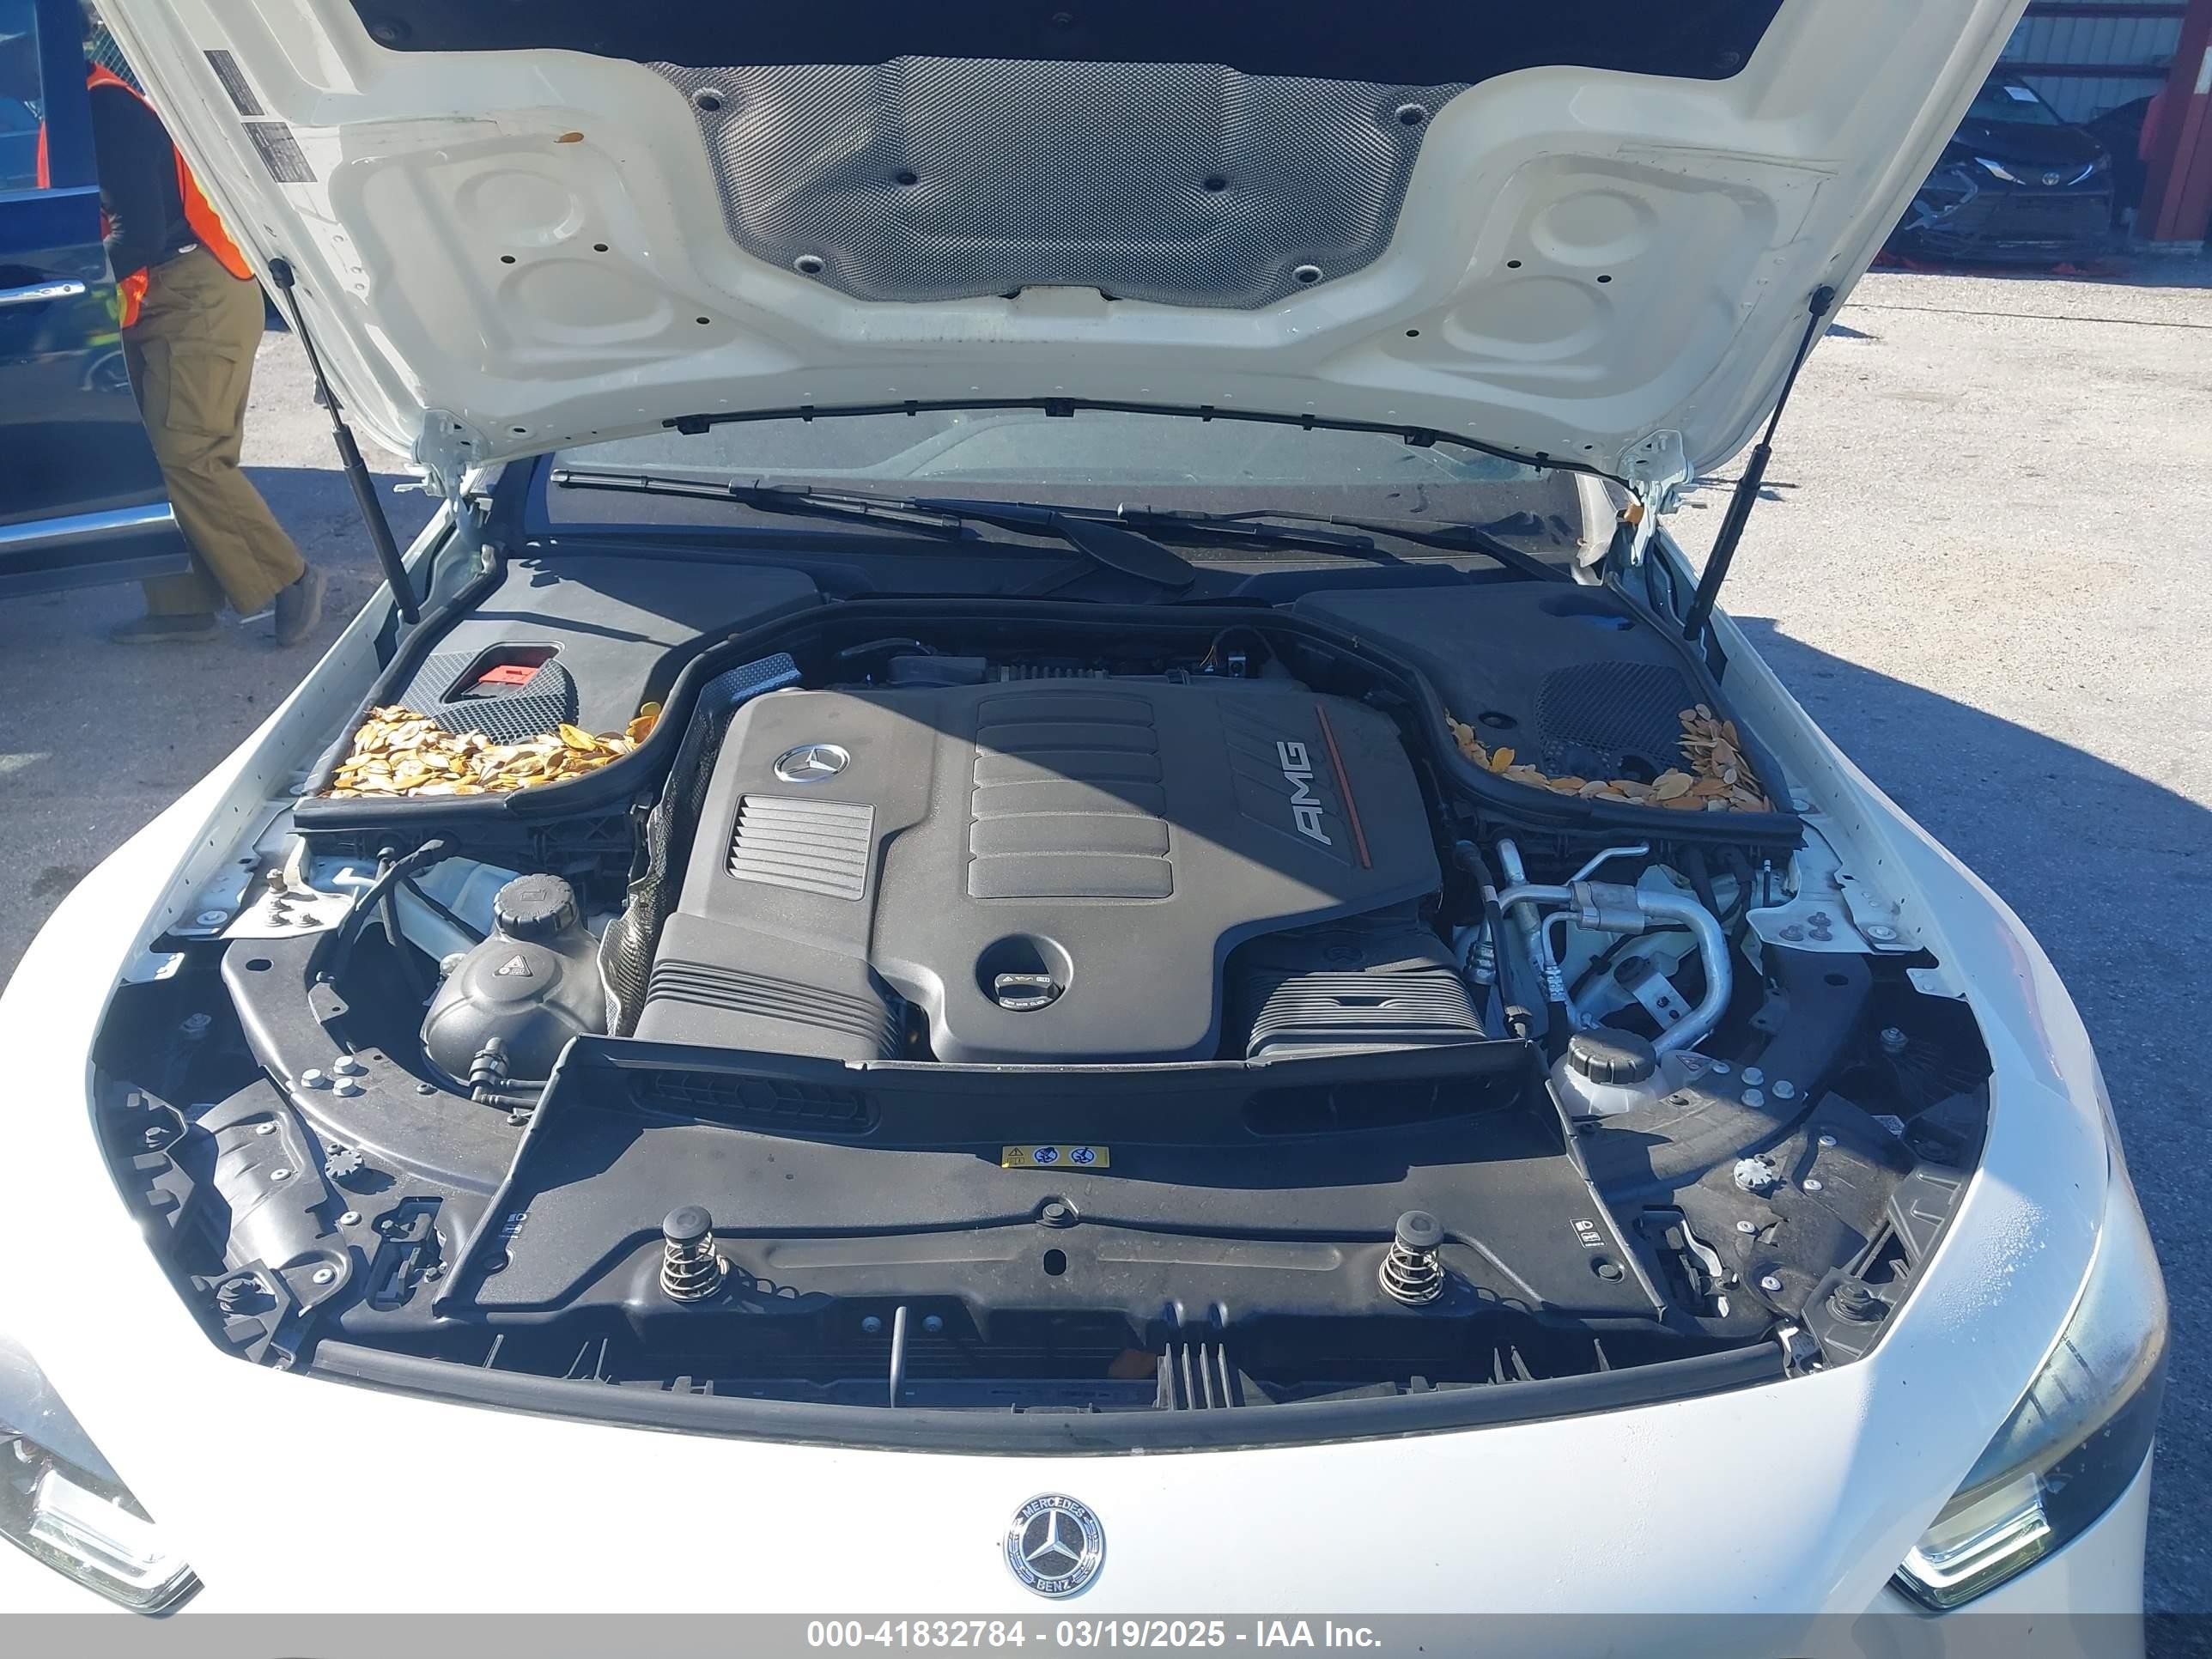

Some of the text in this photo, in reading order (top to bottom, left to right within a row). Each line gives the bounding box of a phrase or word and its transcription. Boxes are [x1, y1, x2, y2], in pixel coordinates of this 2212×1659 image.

[1276, 741, 1332, 846] AMG
[1022, 1497, 1086, 1518] MERCEDES
[1036, 1578, 1073, 1593] BENZ
